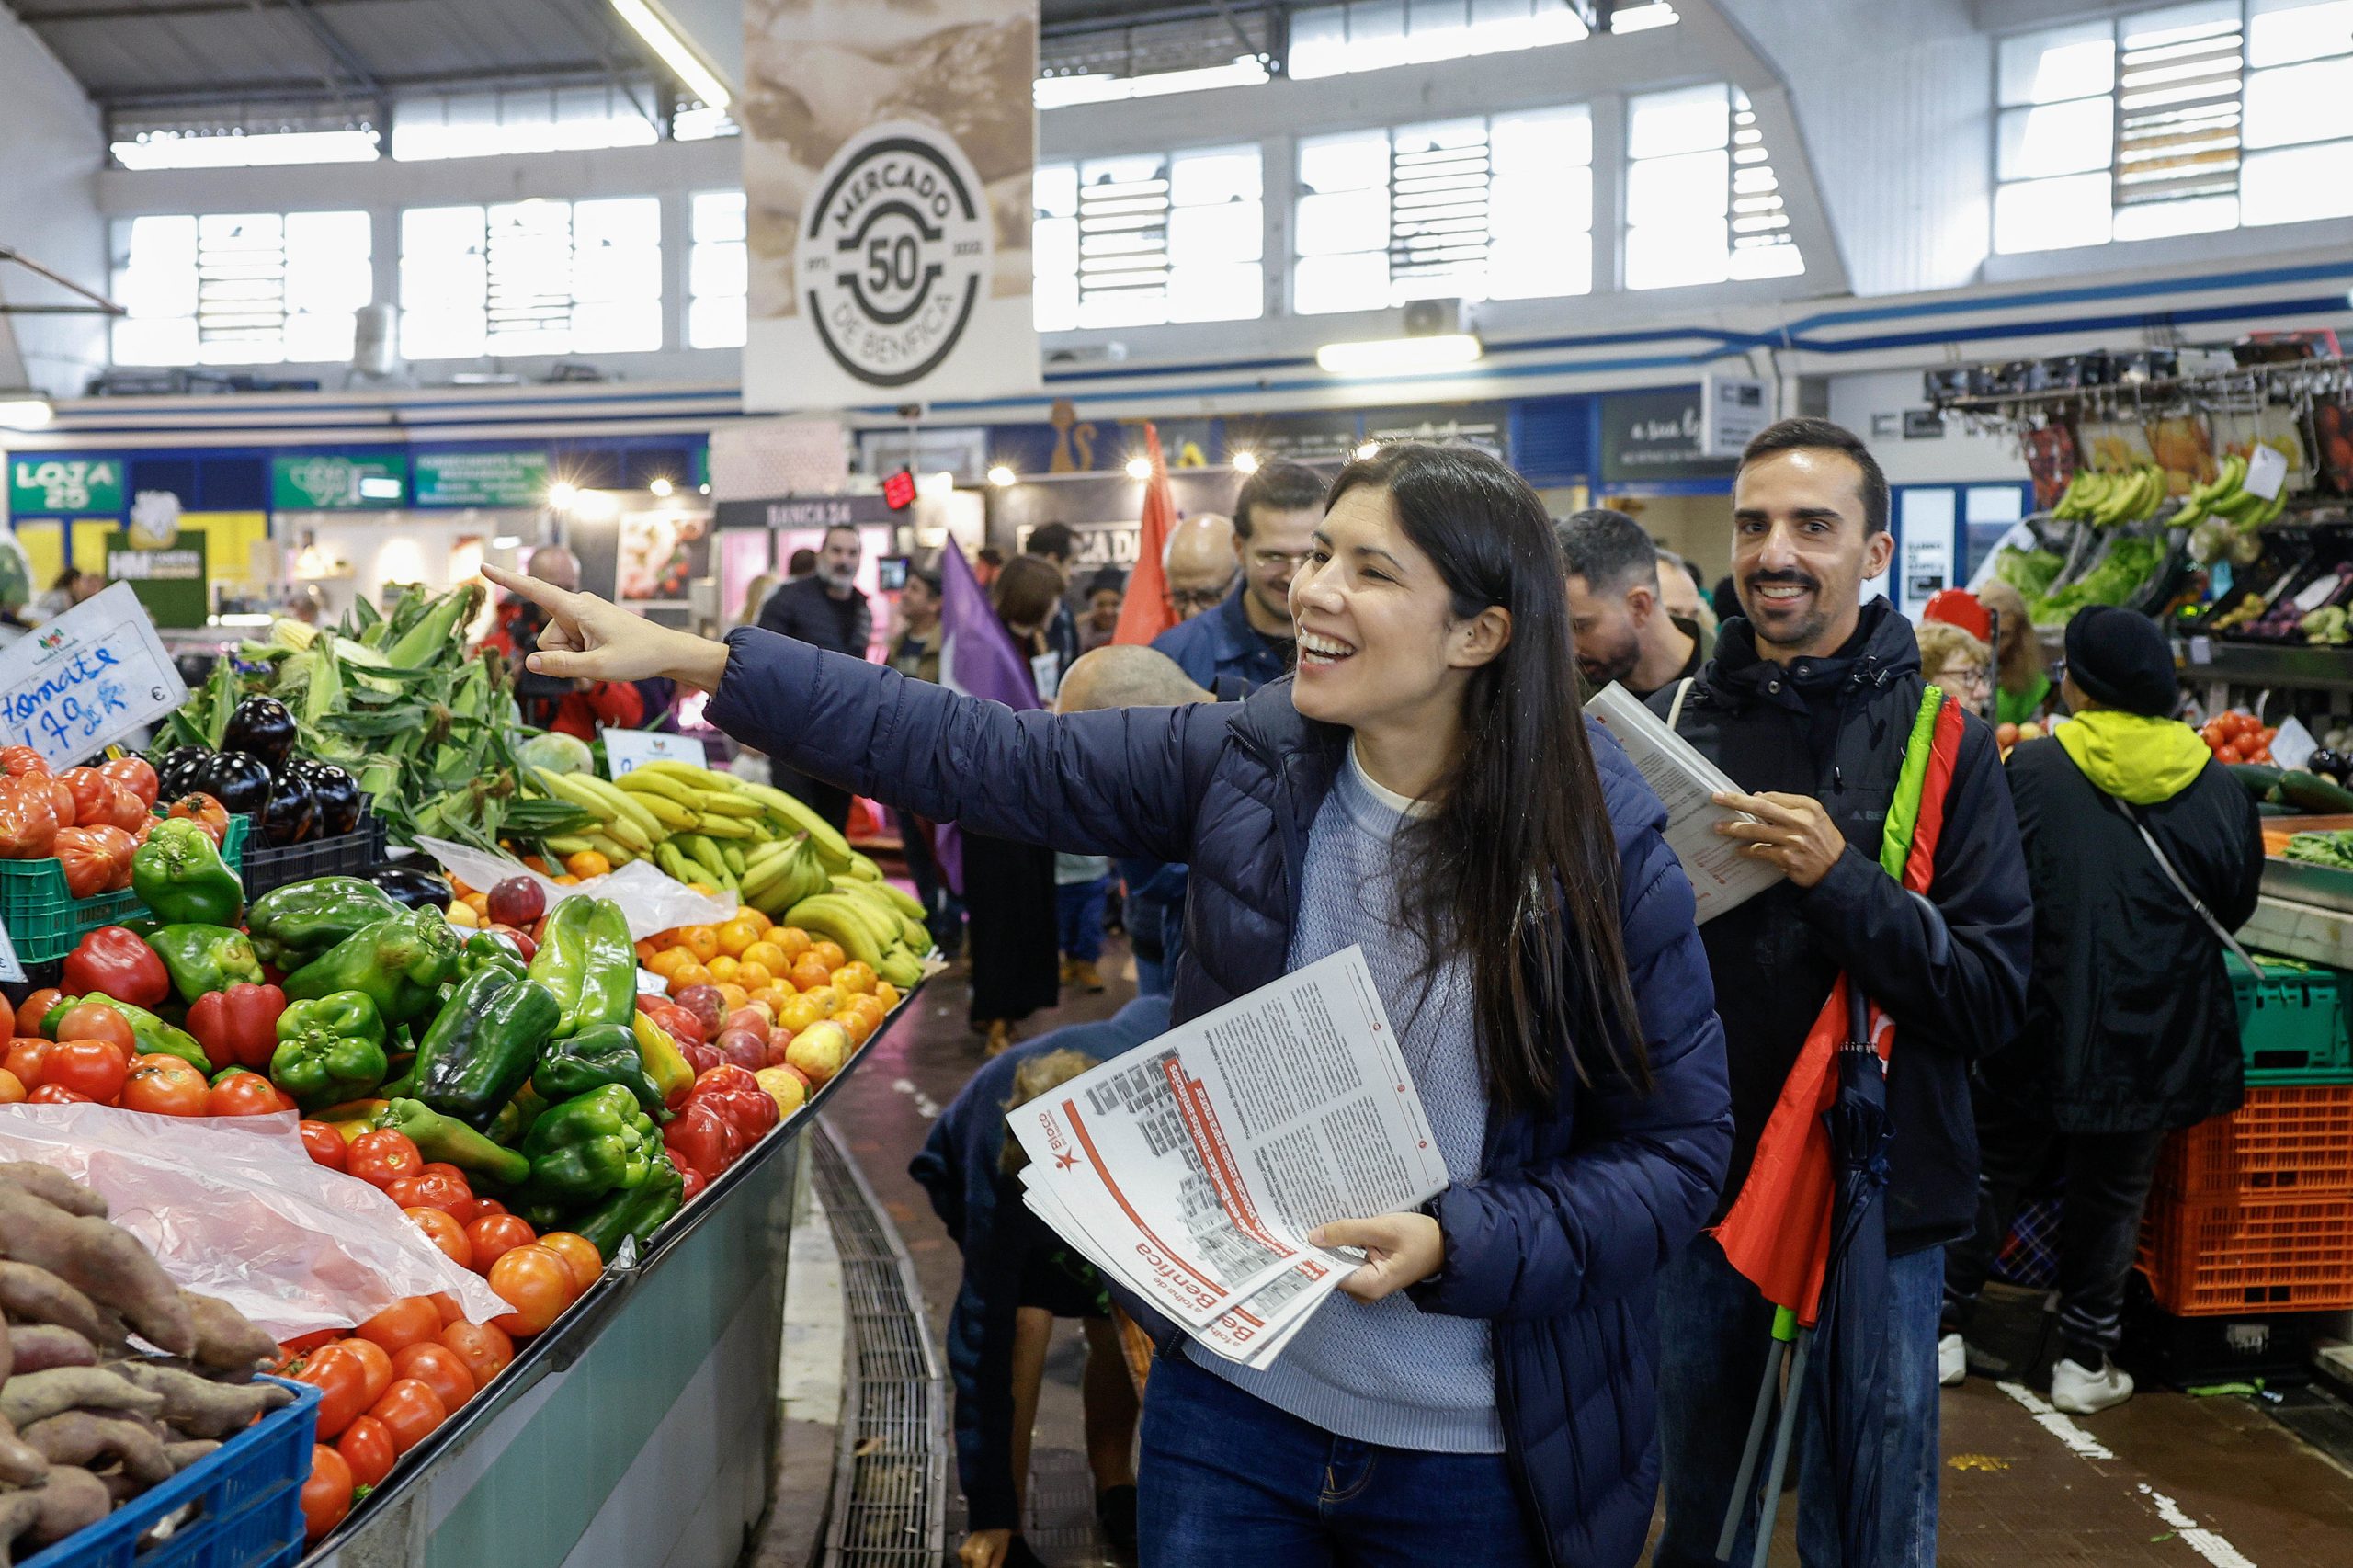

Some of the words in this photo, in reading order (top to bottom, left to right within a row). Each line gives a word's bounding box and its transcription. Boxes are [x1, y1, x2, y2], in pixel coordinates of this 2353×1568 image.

[835, 163, 952, 229] MERCADO
[868, 234, 917, 293] 50
[16, 461, 115, 489] LOJA
[44, 487, 90, 509] 25
[151, 685, 165, 702] €
[1165, 1063, 1196, 1116] anúncios
[1193, 1085, 1215, 1121] morar
[1037, 1111, 1062, 1151] Bloco
[1187, 1113, 1211, 1153] muitos
[1207, 1119, 1226, 1146] para
[1204, 1151, 1232, 1200] Benfica:
[1218, 1144, 1239, 1178] casas
[1226, 1198, 1241, 1218] em
[1232, 1176, 1257, 1219] poucas
[1133, 1241, 1218, 1310] Benfica
[1153, 1276, 1167, 1290] de
[1166, 1287, 1192, 1309] folha
